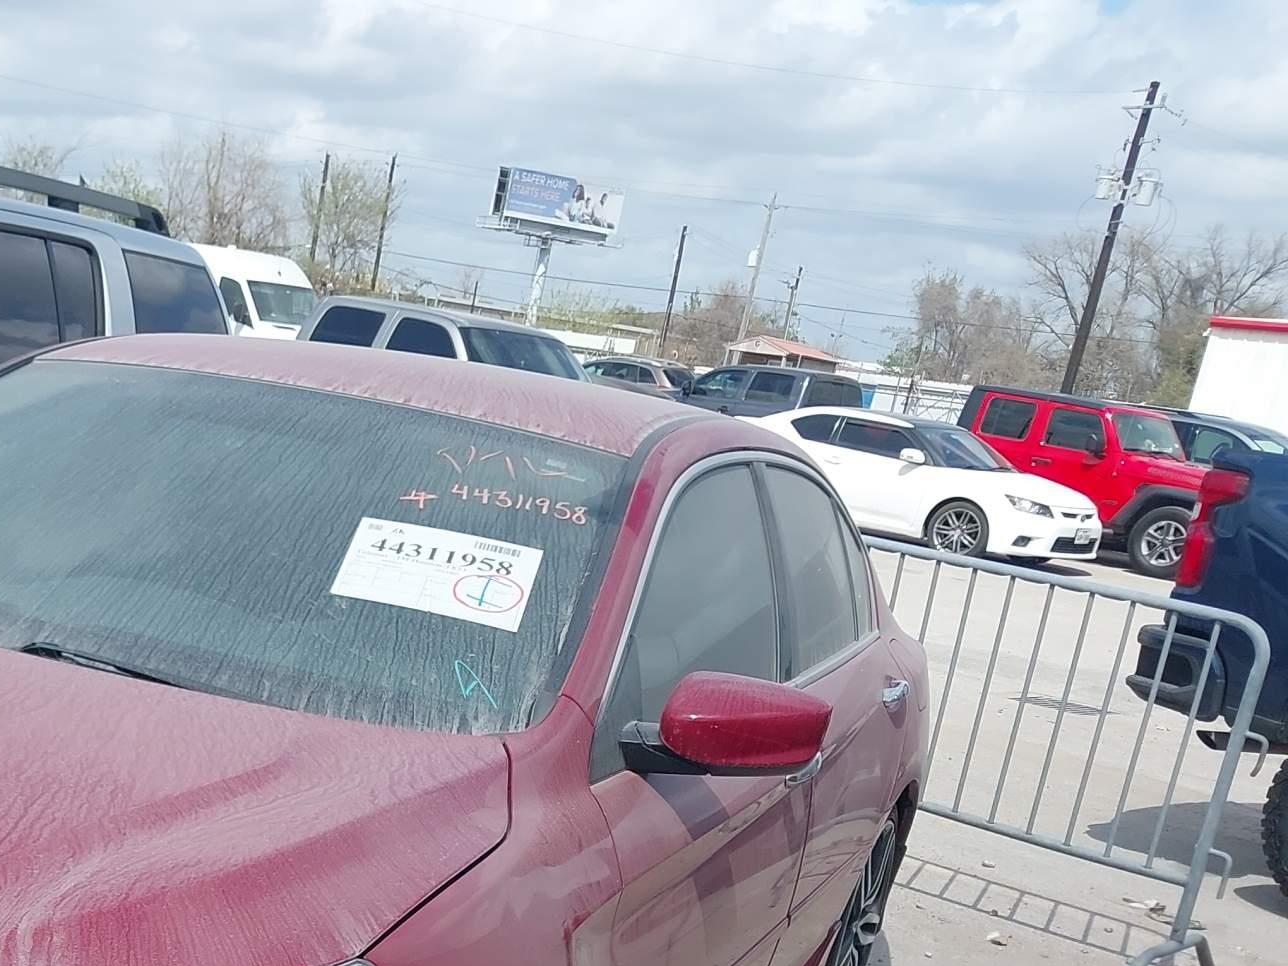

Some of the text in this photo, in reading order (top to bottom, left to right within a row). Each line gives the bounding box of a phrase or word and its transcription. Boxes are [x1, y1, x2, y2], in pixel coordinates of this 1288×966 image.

[521, 172, 546, 185] SAFER
[546, 178, 570, 191] HOME
[451, 484, 588, 526] 44311958
[370, 538, 513, 576] 44311958
